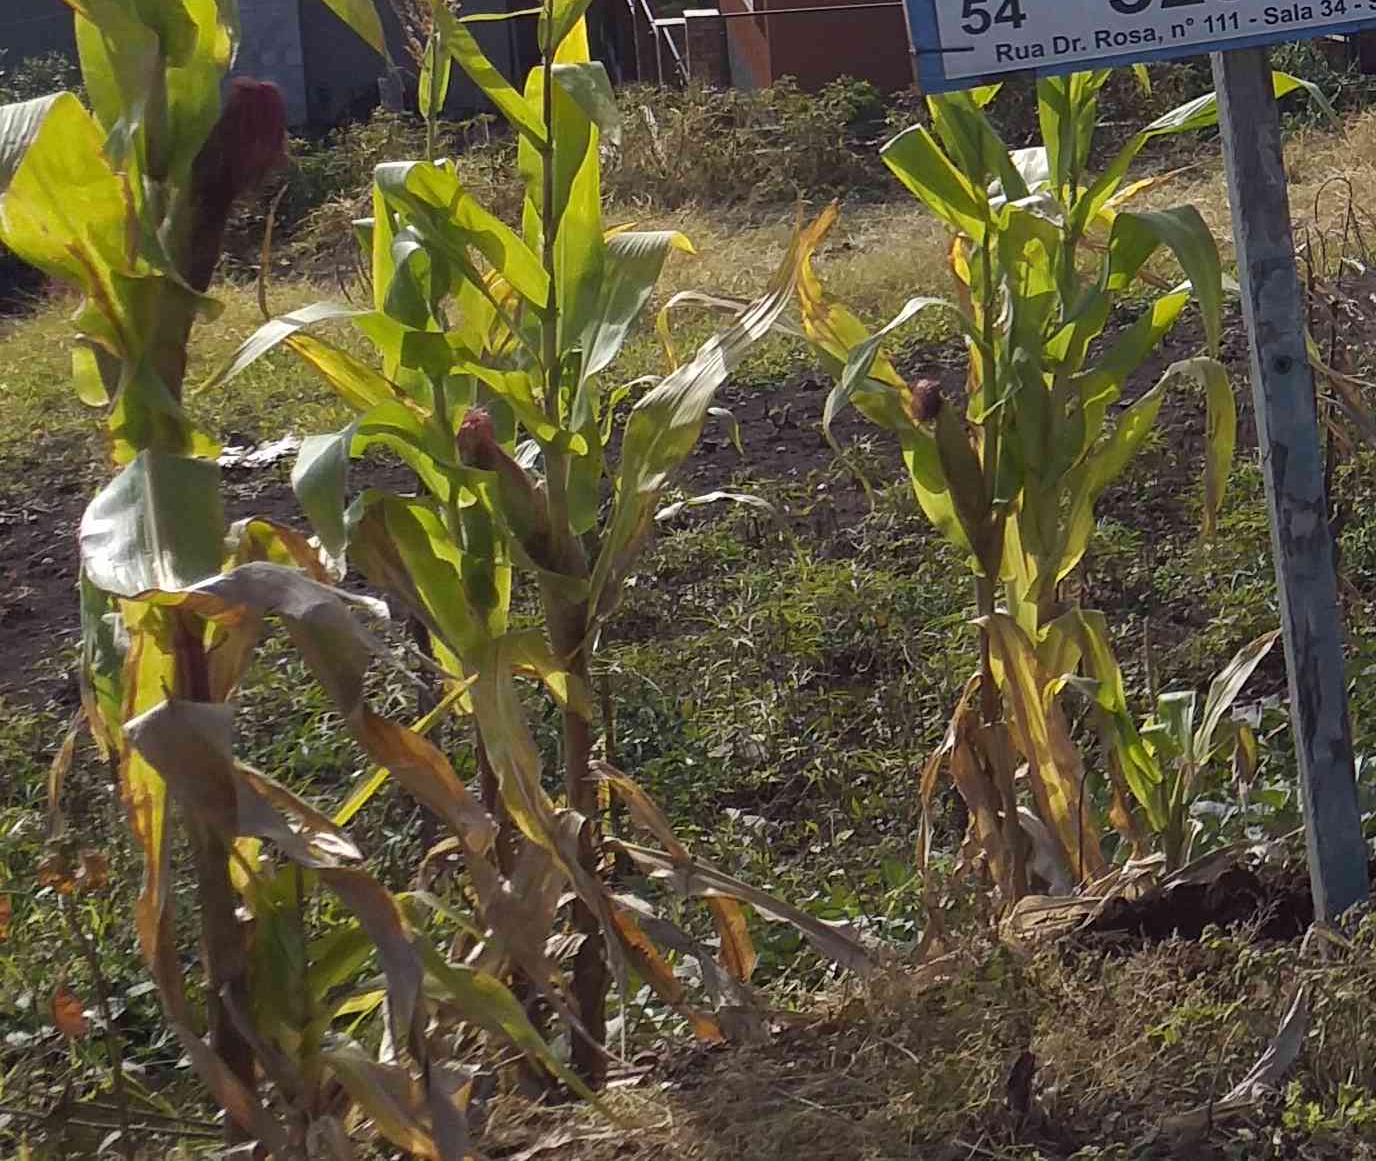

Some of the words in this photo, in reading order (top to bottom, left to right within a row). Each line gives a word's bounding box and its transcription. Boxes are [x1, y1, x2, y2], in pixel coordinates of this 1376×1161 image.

[995, 41, 1045, 64] Rua
[1053, 35, 1087, 55] Dr.
[1095, 24, 1164, 50] Rosa,
[1203, 11, 1241, 34] 111
[1264, 3, 1313, 26] Sala
